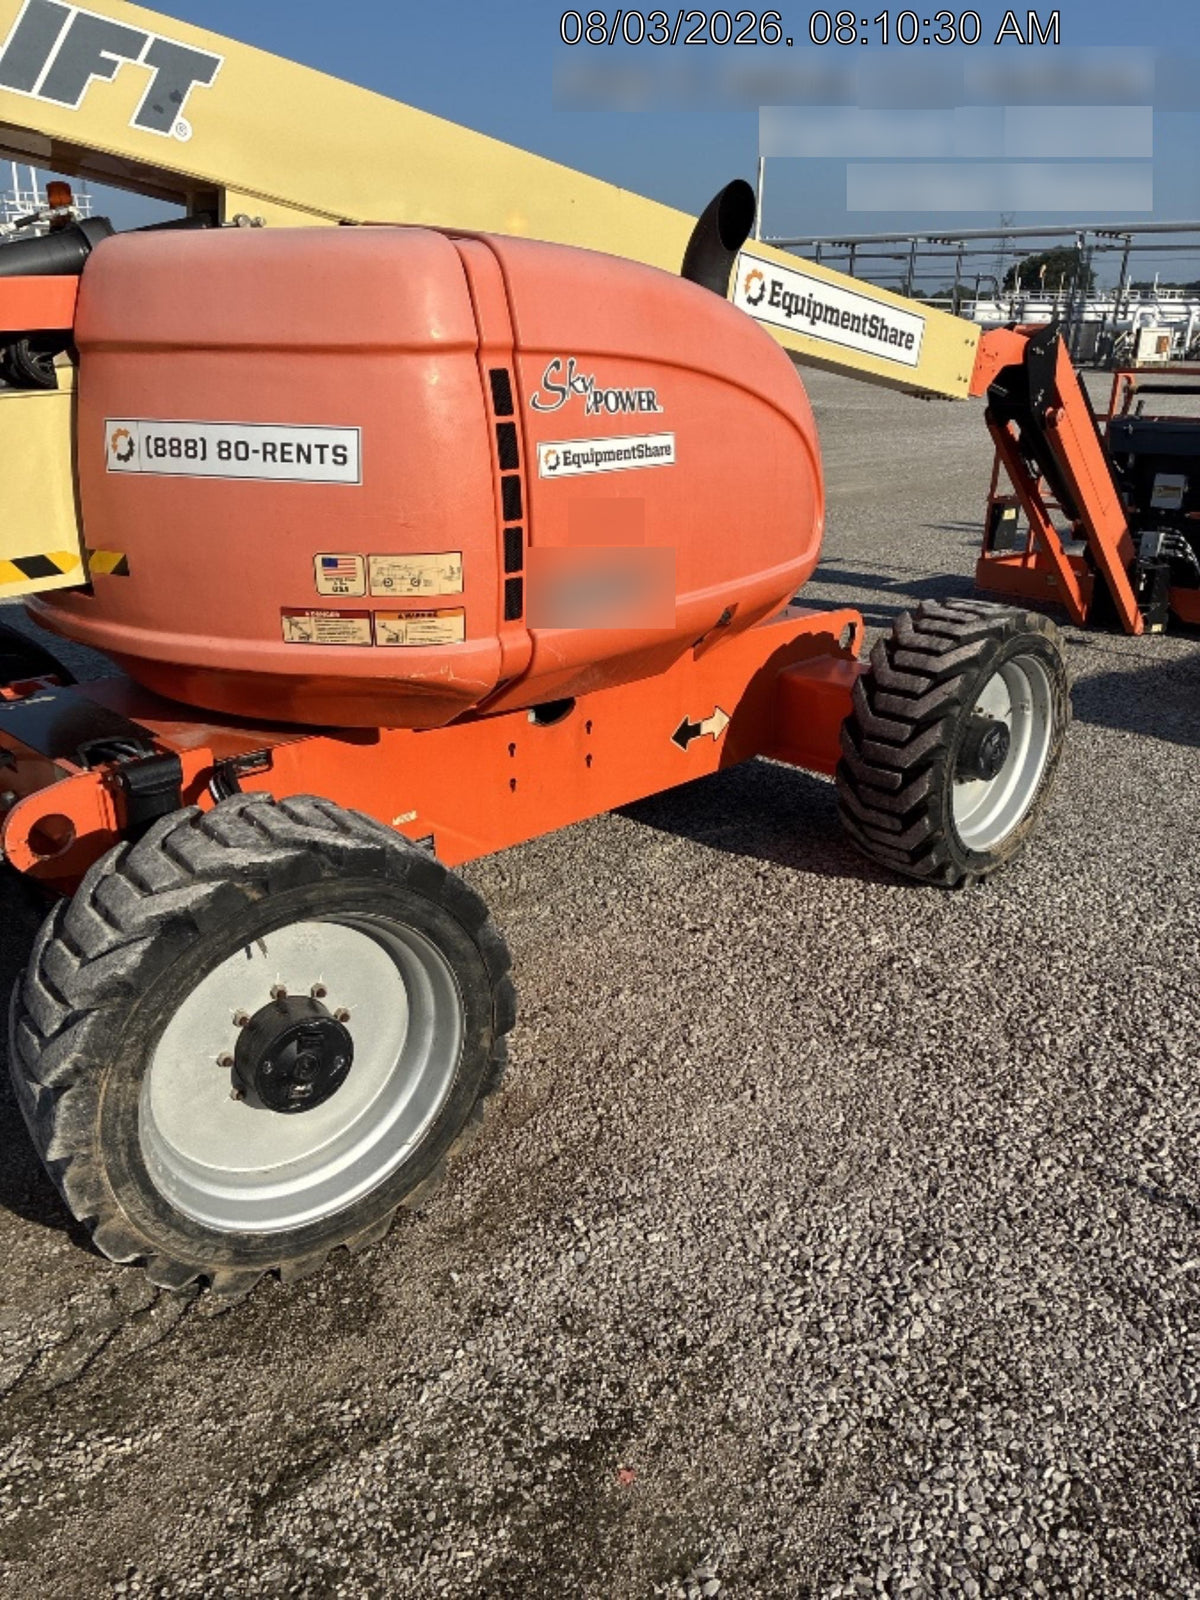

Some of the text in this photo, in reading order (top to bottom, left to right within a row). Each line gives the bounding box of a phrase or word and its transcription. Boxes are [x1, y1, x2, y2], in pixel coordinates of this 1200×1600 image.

[768, 279, 915, 351] EquipmentShare
[531, 358, 658, 415] Sky POWER
[145, 435, 348, 466] (888) 80-RENTS
[562, 443, 672, 468] EquipmentShare
